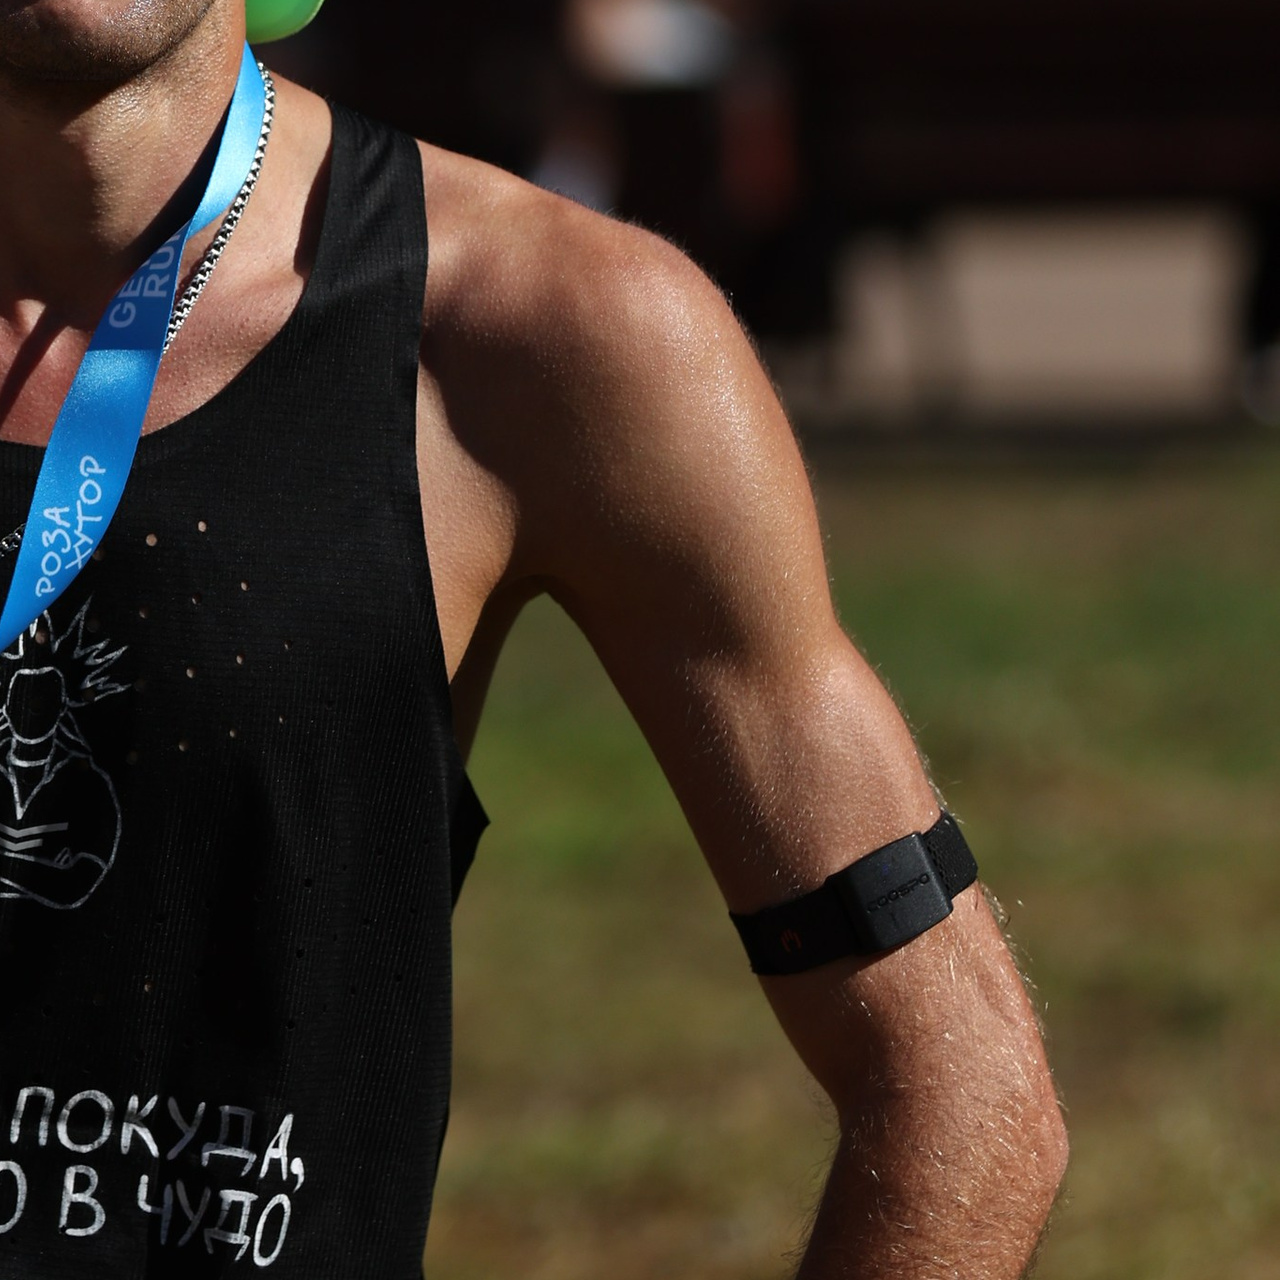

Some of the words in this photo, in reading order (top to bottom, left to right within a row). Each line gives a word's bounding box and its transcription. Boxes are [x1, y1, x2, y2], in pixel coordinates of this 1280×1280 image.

[109, 260, 151, 329] GE
[35, 504, 71, 598] РОЗА
[65, 454, 107, 571] ХУТОР
[9, 1084, 306, 1194] ПОКУДА,
[59, 1164, 107, 1238] В
[136, 1173, 293, 1267] ЧУДО
